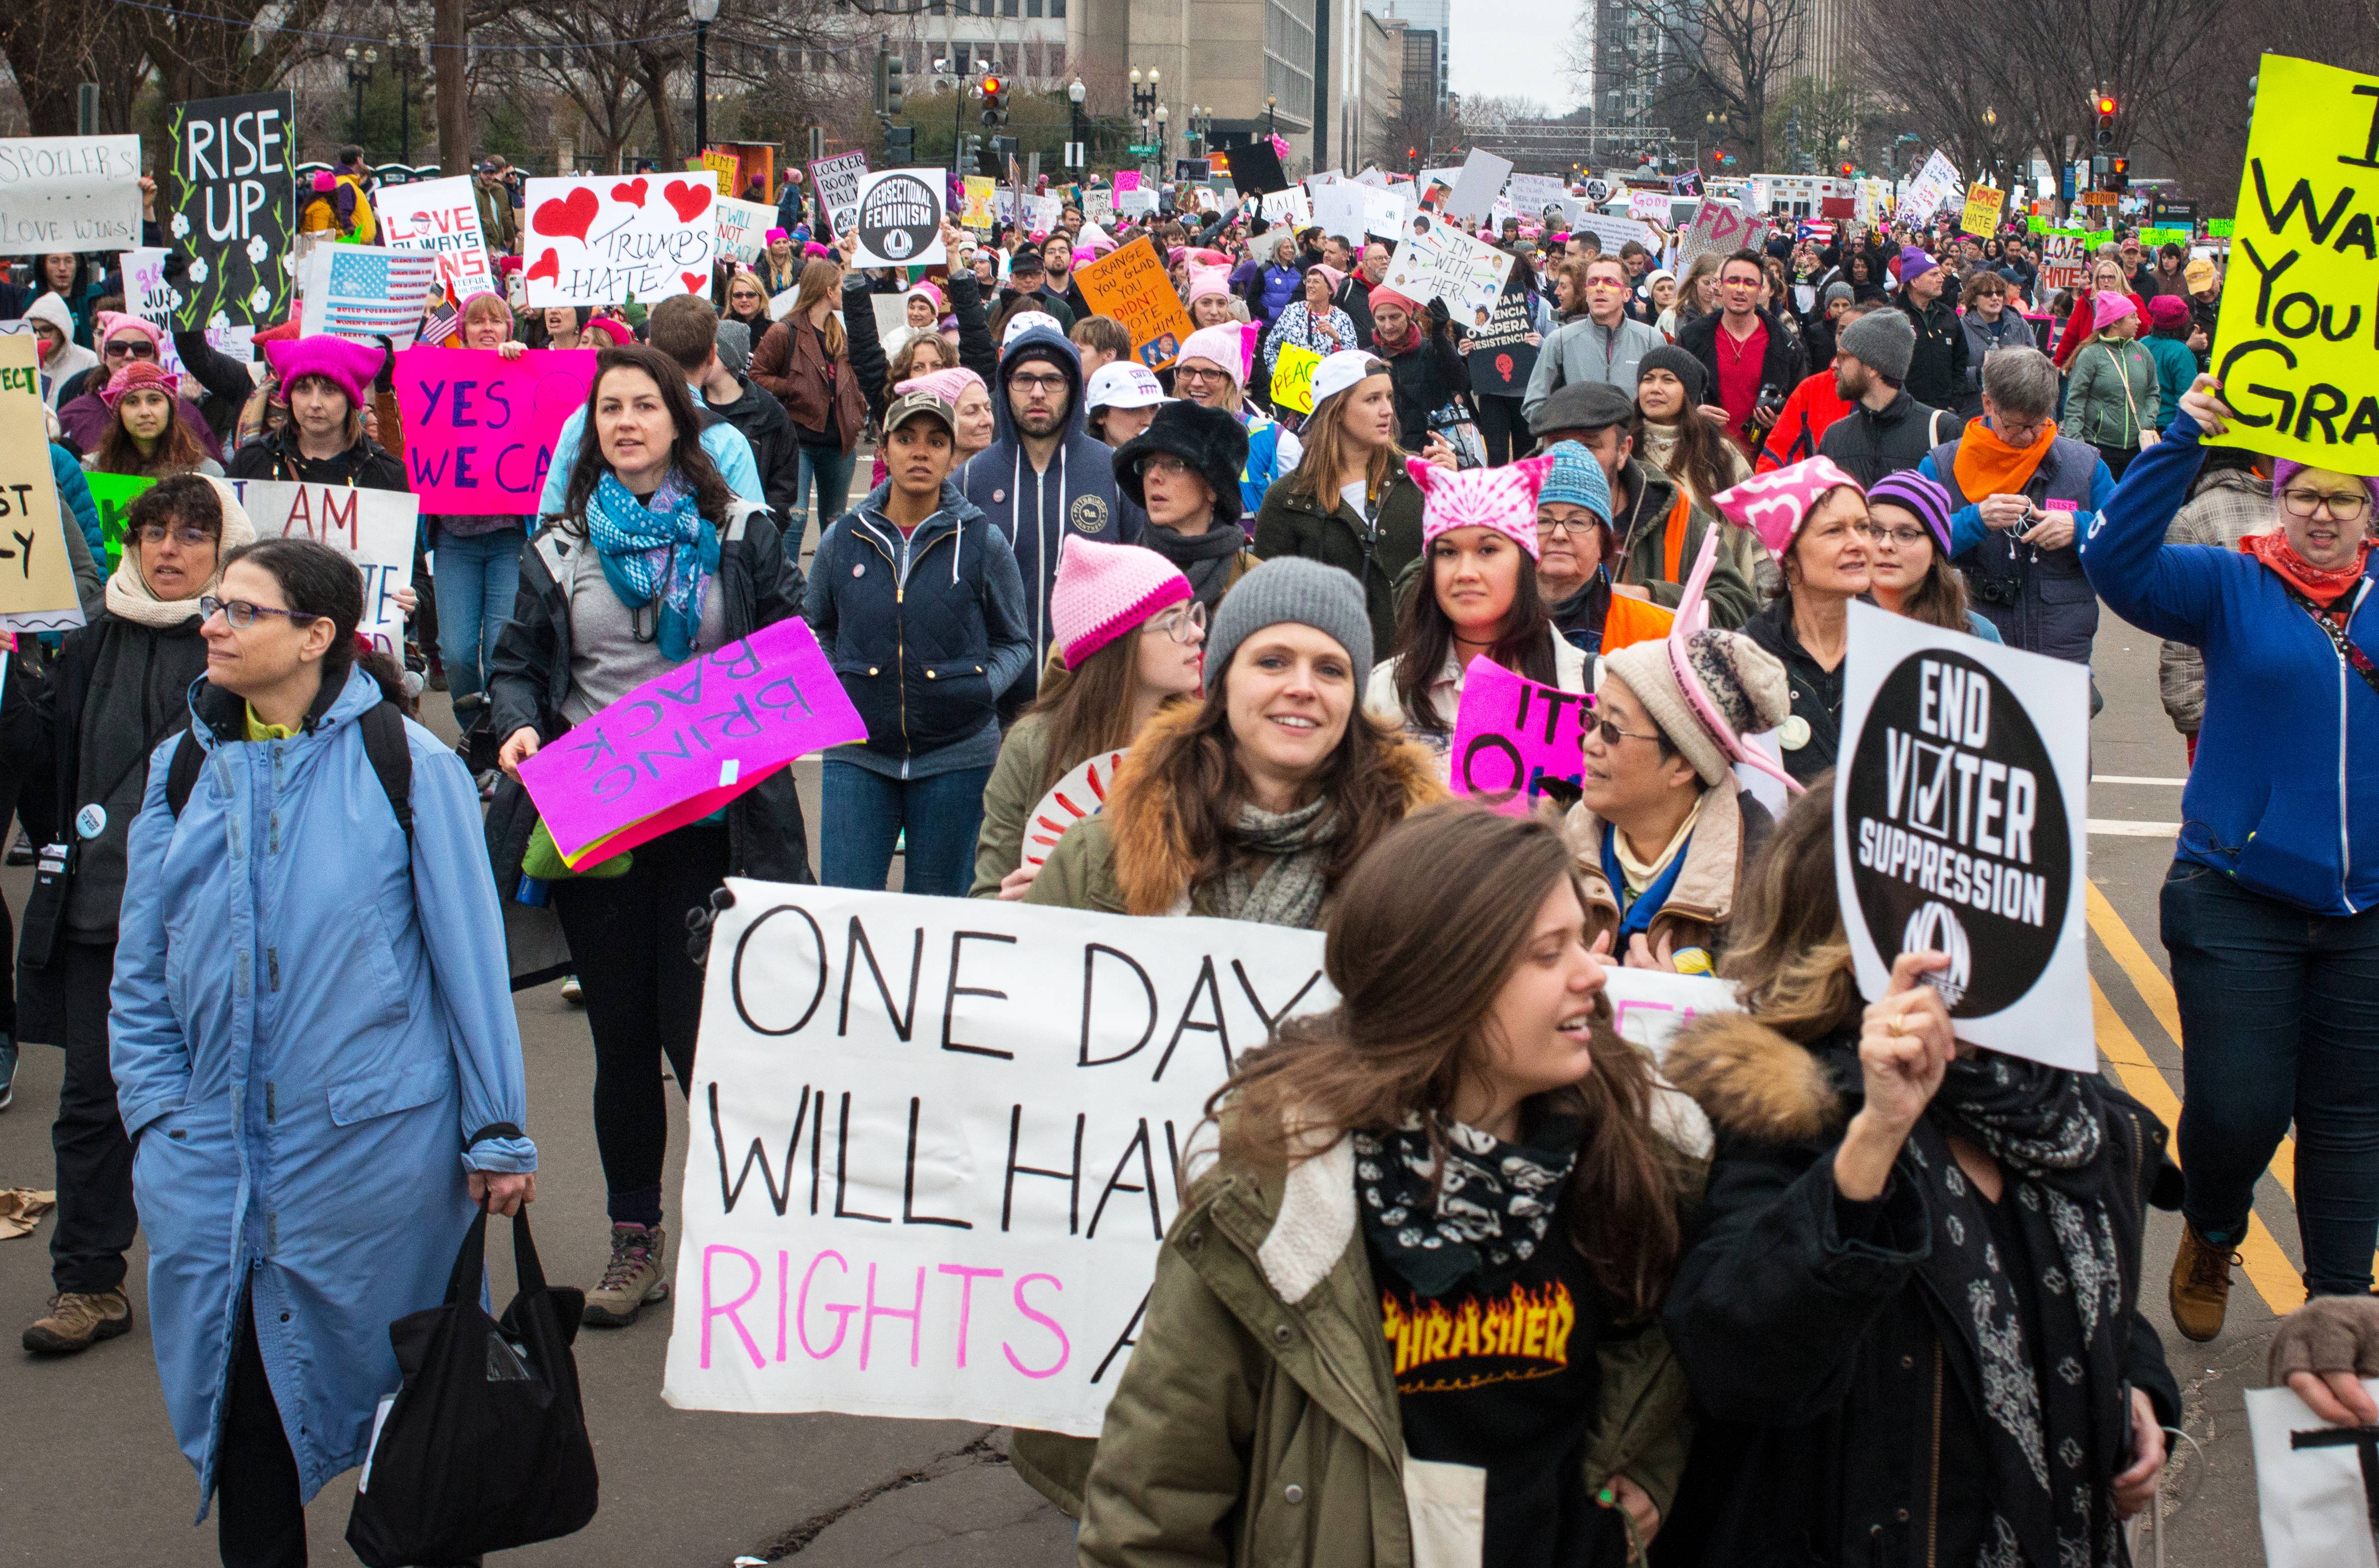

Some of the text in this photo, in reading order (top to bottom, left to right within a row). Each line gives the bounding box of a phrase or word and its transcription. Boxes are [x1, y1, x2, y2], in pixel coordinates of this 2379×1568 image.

[188, 109, 283, 181] RISE
[812, 155, 866, 177] LOCKER
[820, 173, 857, 192] ROOM
[206, 180, 266, 242] UP
[866, 179, 932, 211] INTERSECTIONAL
[1969, 183, 2002, 208] LOVE
[2085, 194, 2115, 204] DETOUR
[2251, 157, 2379, 261] WA
[728, 207, 751, 230] WILL
[865, 204, 931, 229] FEMINISM
[1965, 214, 1991, 230] HATE
[1, 221, 58, 246] LOVE
[592, 214, 709, 264] TRUMPS
[718, 224, 744, 244] NOT
[1448, 237, 1474, 260] I'M
[2044, 235, 2084, 260] LOVE
[1092, 244, 1145, 280] ORANGE
[1094, 258, 1155, 297] YOU GLAD
[1435, 252, 1474, 282] WITH
[2043, 266, 2082, 290] HATE
[562, 264, 680, 300] HATE!
[1117, 279, 1142, 299] YOU
[1429, 275, 1465, 301] HER!
[1512, 292, 1525, 303] MI
[2240, 238, 2361, 342] YOU
[1113, 285, 1158, 321] DIDN'T
[1153, 309, 1183, 335] HIM?
[1466, 329, 1478, 340] O
[1273, 361, 1319, 396] PEAC
[411, 443, 552, 494] WE CA
[282, 484, 358, 550] AM
[567, 638, 763, 772] BACK
[1918, 659, 1991, 749] END
[592, 676, 815, 805] BRING
[1859, 816, 2046, 927] SUPPRESSION
[731, 904, 1323, 1083] ONE DAY
[708, 1081, 974, 1231] WILL
[701, 1244, 1072, 1380] RIGHTS
